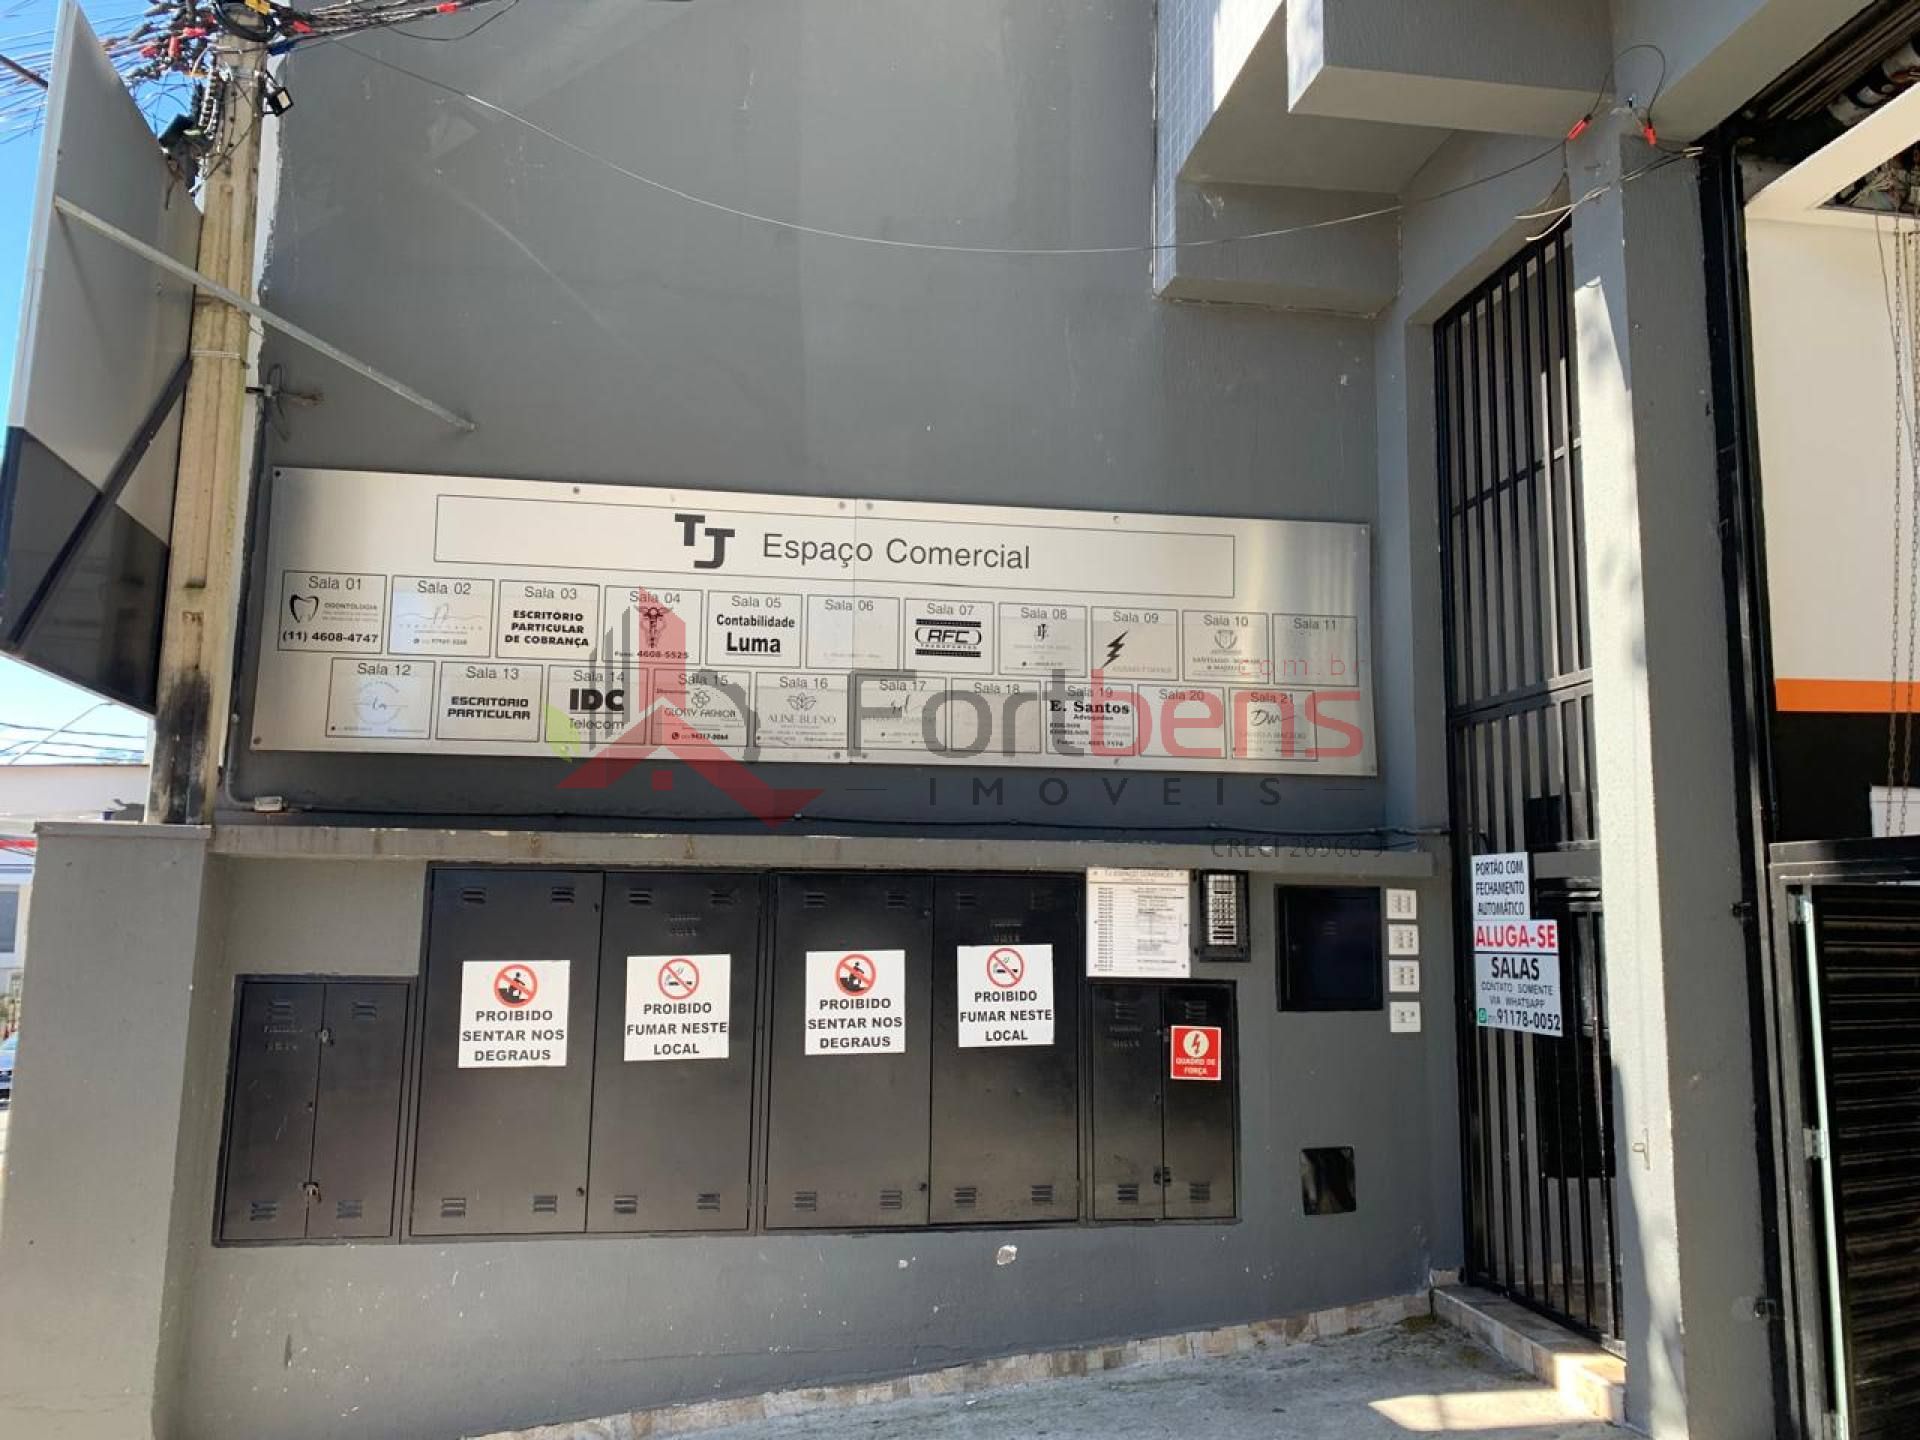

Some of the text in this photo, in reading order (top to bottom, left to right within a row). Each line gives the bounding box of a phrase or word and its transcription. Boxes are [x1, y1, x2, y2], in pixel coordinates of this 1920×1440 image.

[763, 533, 873, 567] Espaço
[886, 538, 1030, 570] Comercial
[308, 575, 361, 590] Sala 01
[417, 580, 472, 595] Sala 02
[524, 586, 577, 600] Sala 03
[629, 590, 681, 604] Sala 04
[731, 594, 782, 609] Sala 05
[824, 598, 874, 612] Sala 06
[926, 602, 974, 616] Sala 07
[1020, 607, 1068, 620] Sala 08
[716, 614, 796, 628] Contabilidade
[1112, 611, 1159, 624] Sala 09
[1203, 614, 1249, 627] Sala 10
[511, 622, 584, 634] PARTICULAR
[1293, 618, 1336, 631] Sala 11
[282, 630, 379, 643] (11) 4608-4747
[504, 634, 589, 648] DE COBRANÇA
[726, 631, 781, 653] Luma
[927, 629, 970, 643] RFC
[357, 662, 411, 676] Sala 12
[466, 665, 519, 680] Sala 13
[573, 669, 625, 682] Sala 14
[678, 673, 708, 685] Sala
[779, 676, 828, 689] Sala 16
[879, 679, 927, 691] Sala 17
[974, 682, 1021, 695] Sala 18
[1067, 685, 1093, 697] Sala
[1159, 688, 1205, 701] Sala 20
[569, 688, 625, 712] IDC
[1049, 700, 1131, 714] E. Santos
[447, 708, 531, 720] PARTICULAR
[568, 718, 625, 729] Telecom
[1475, 860, 1525, 875] PORTÃO COM
[1475, 881, 1525, 895] FECHAMENTO
[1477, 900, 1525, 915] AUTOMÁTICO
[1475, 924, 1555, 948] ALUGA-SE
[1491, 956, 1540, 980] SALAS
[1481, 981, 1553, 995] CONTATO SOMENTE
[974, 990, 1038, 1003] PROIBIDO
[643, 1002, 712, 1015] PROIBIDO
[819, 998, 891, 1010] PROIBIDO
[475, 1010, 553, 1021] PROIBIDO
[960, 1009, 1053, 1022] FUMAR NESTE
[1497, 1008, 1561, 1031] 91178-0052
[627, 1022, 728, 1036] FUMAR NESTE
[808, 1017, 903, 1030] SENTAR NOS
[462, 1029, 565, 1042] SENTAR NOS
[985, 1030, 1029, 1042] LOCAL
[653, 1043, 700, 1055] LOCAL
[819, 1036, 891, 1049] DEGRAUS
[474, 1049, 552, 1062] DEGRAUS
[1175, 1058, 1205, 1066] QUADRO
